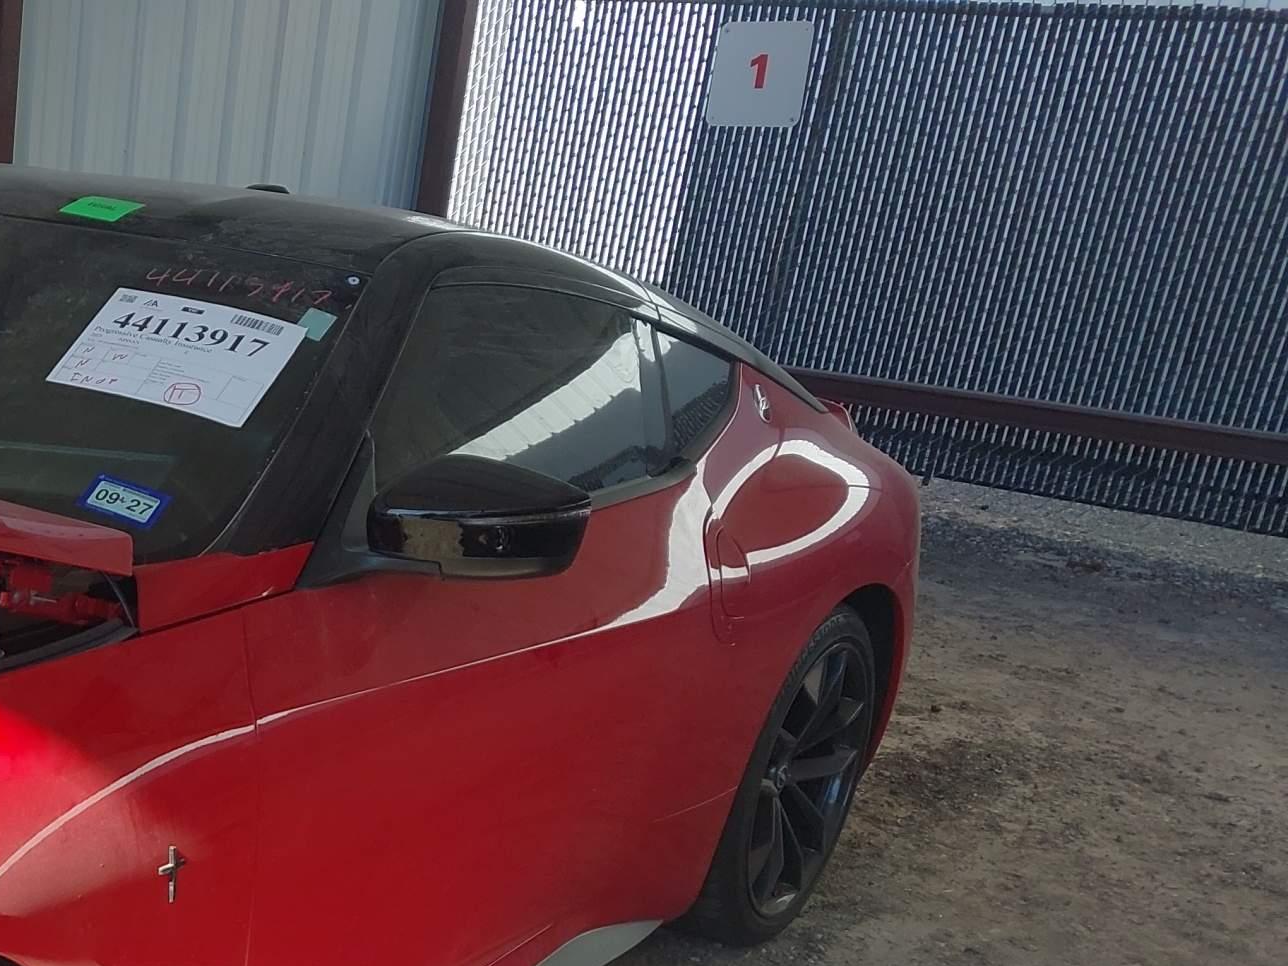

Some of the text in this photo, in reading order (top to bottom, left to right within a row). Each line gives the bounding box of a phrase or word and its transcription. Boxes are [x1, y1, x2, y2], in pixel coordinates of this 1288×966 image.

[749, 53, 770, 89] 1
[113, 311, 271, 357] 44113917
[95, 488, 121, 505] 09
[125, 498, 154, 515] 27
